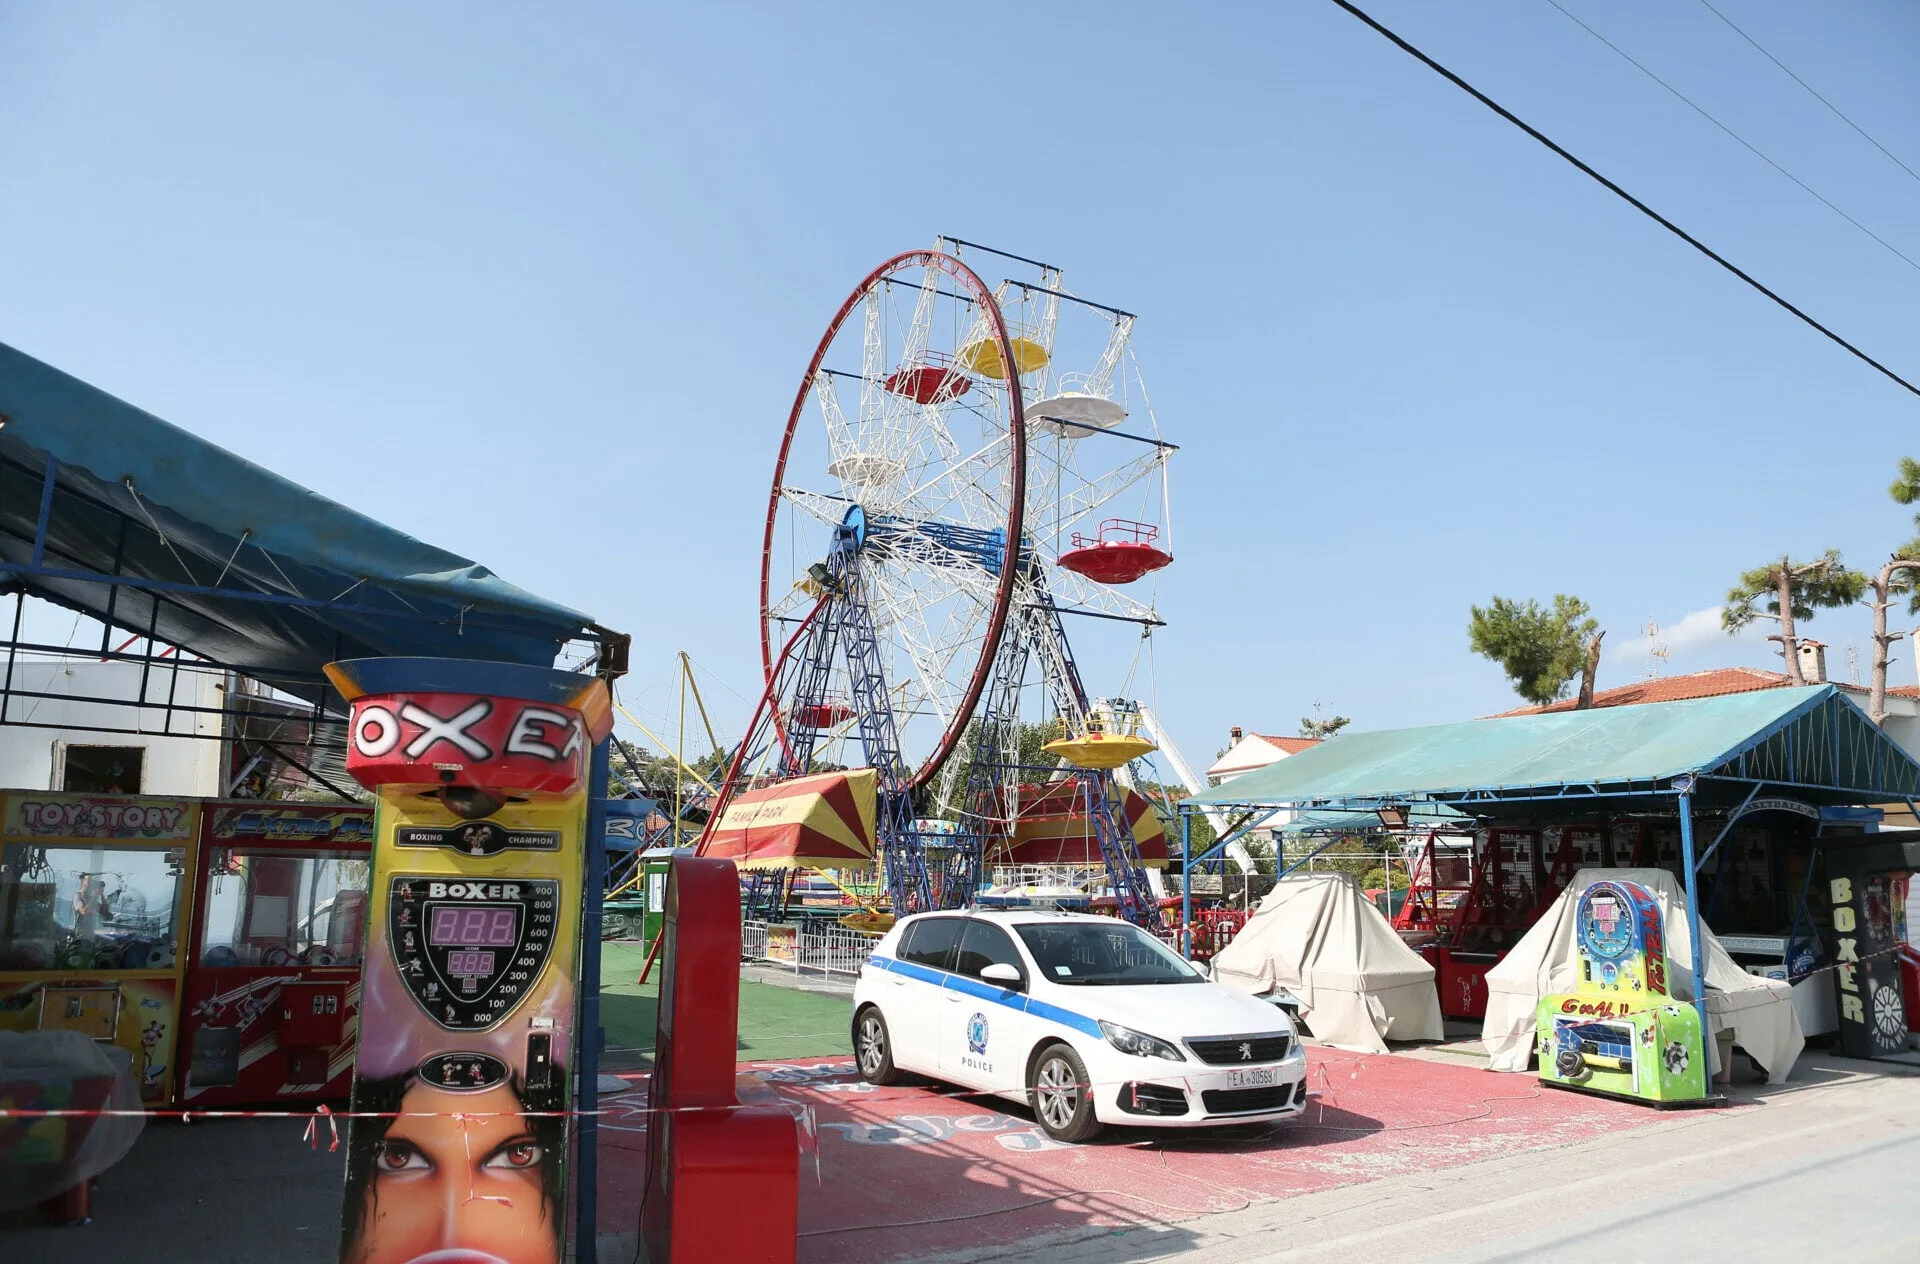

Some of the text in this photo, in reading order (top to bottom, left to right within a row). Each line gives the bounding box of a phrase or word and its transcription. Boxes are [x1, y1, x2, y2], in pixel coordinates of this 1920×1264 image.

[351, 698, 584, 762] OXE
[22, 803, 181, 830] TOY STORY
[760, 805, 788, 819] PARK
[235, 812, 331, 836] EXTRA
[410, 833, 553, 845] BOXING CHAMPION
[429, 882, 521, 899] BOXER
[535, 887, 552, 895] 900
[534, 901, 552, 909] 800
[534, 915, 551, 923] 700
[530, 929, 548, 937] 600
[525, 943, 542, 951] 500
[1830, 877, 1865, 1024] BOXER
[518, 957, 535, 966] 400
[510, 972, 528, 980] 300
[499, 985, 517, 994] 200
[489, 1000, 505, 1008] 100
[474, 1013, 492, 1022] 000
[962, 1057, 993, 1073] POLICE
[1233, 1072, 1245, 1086] EA
